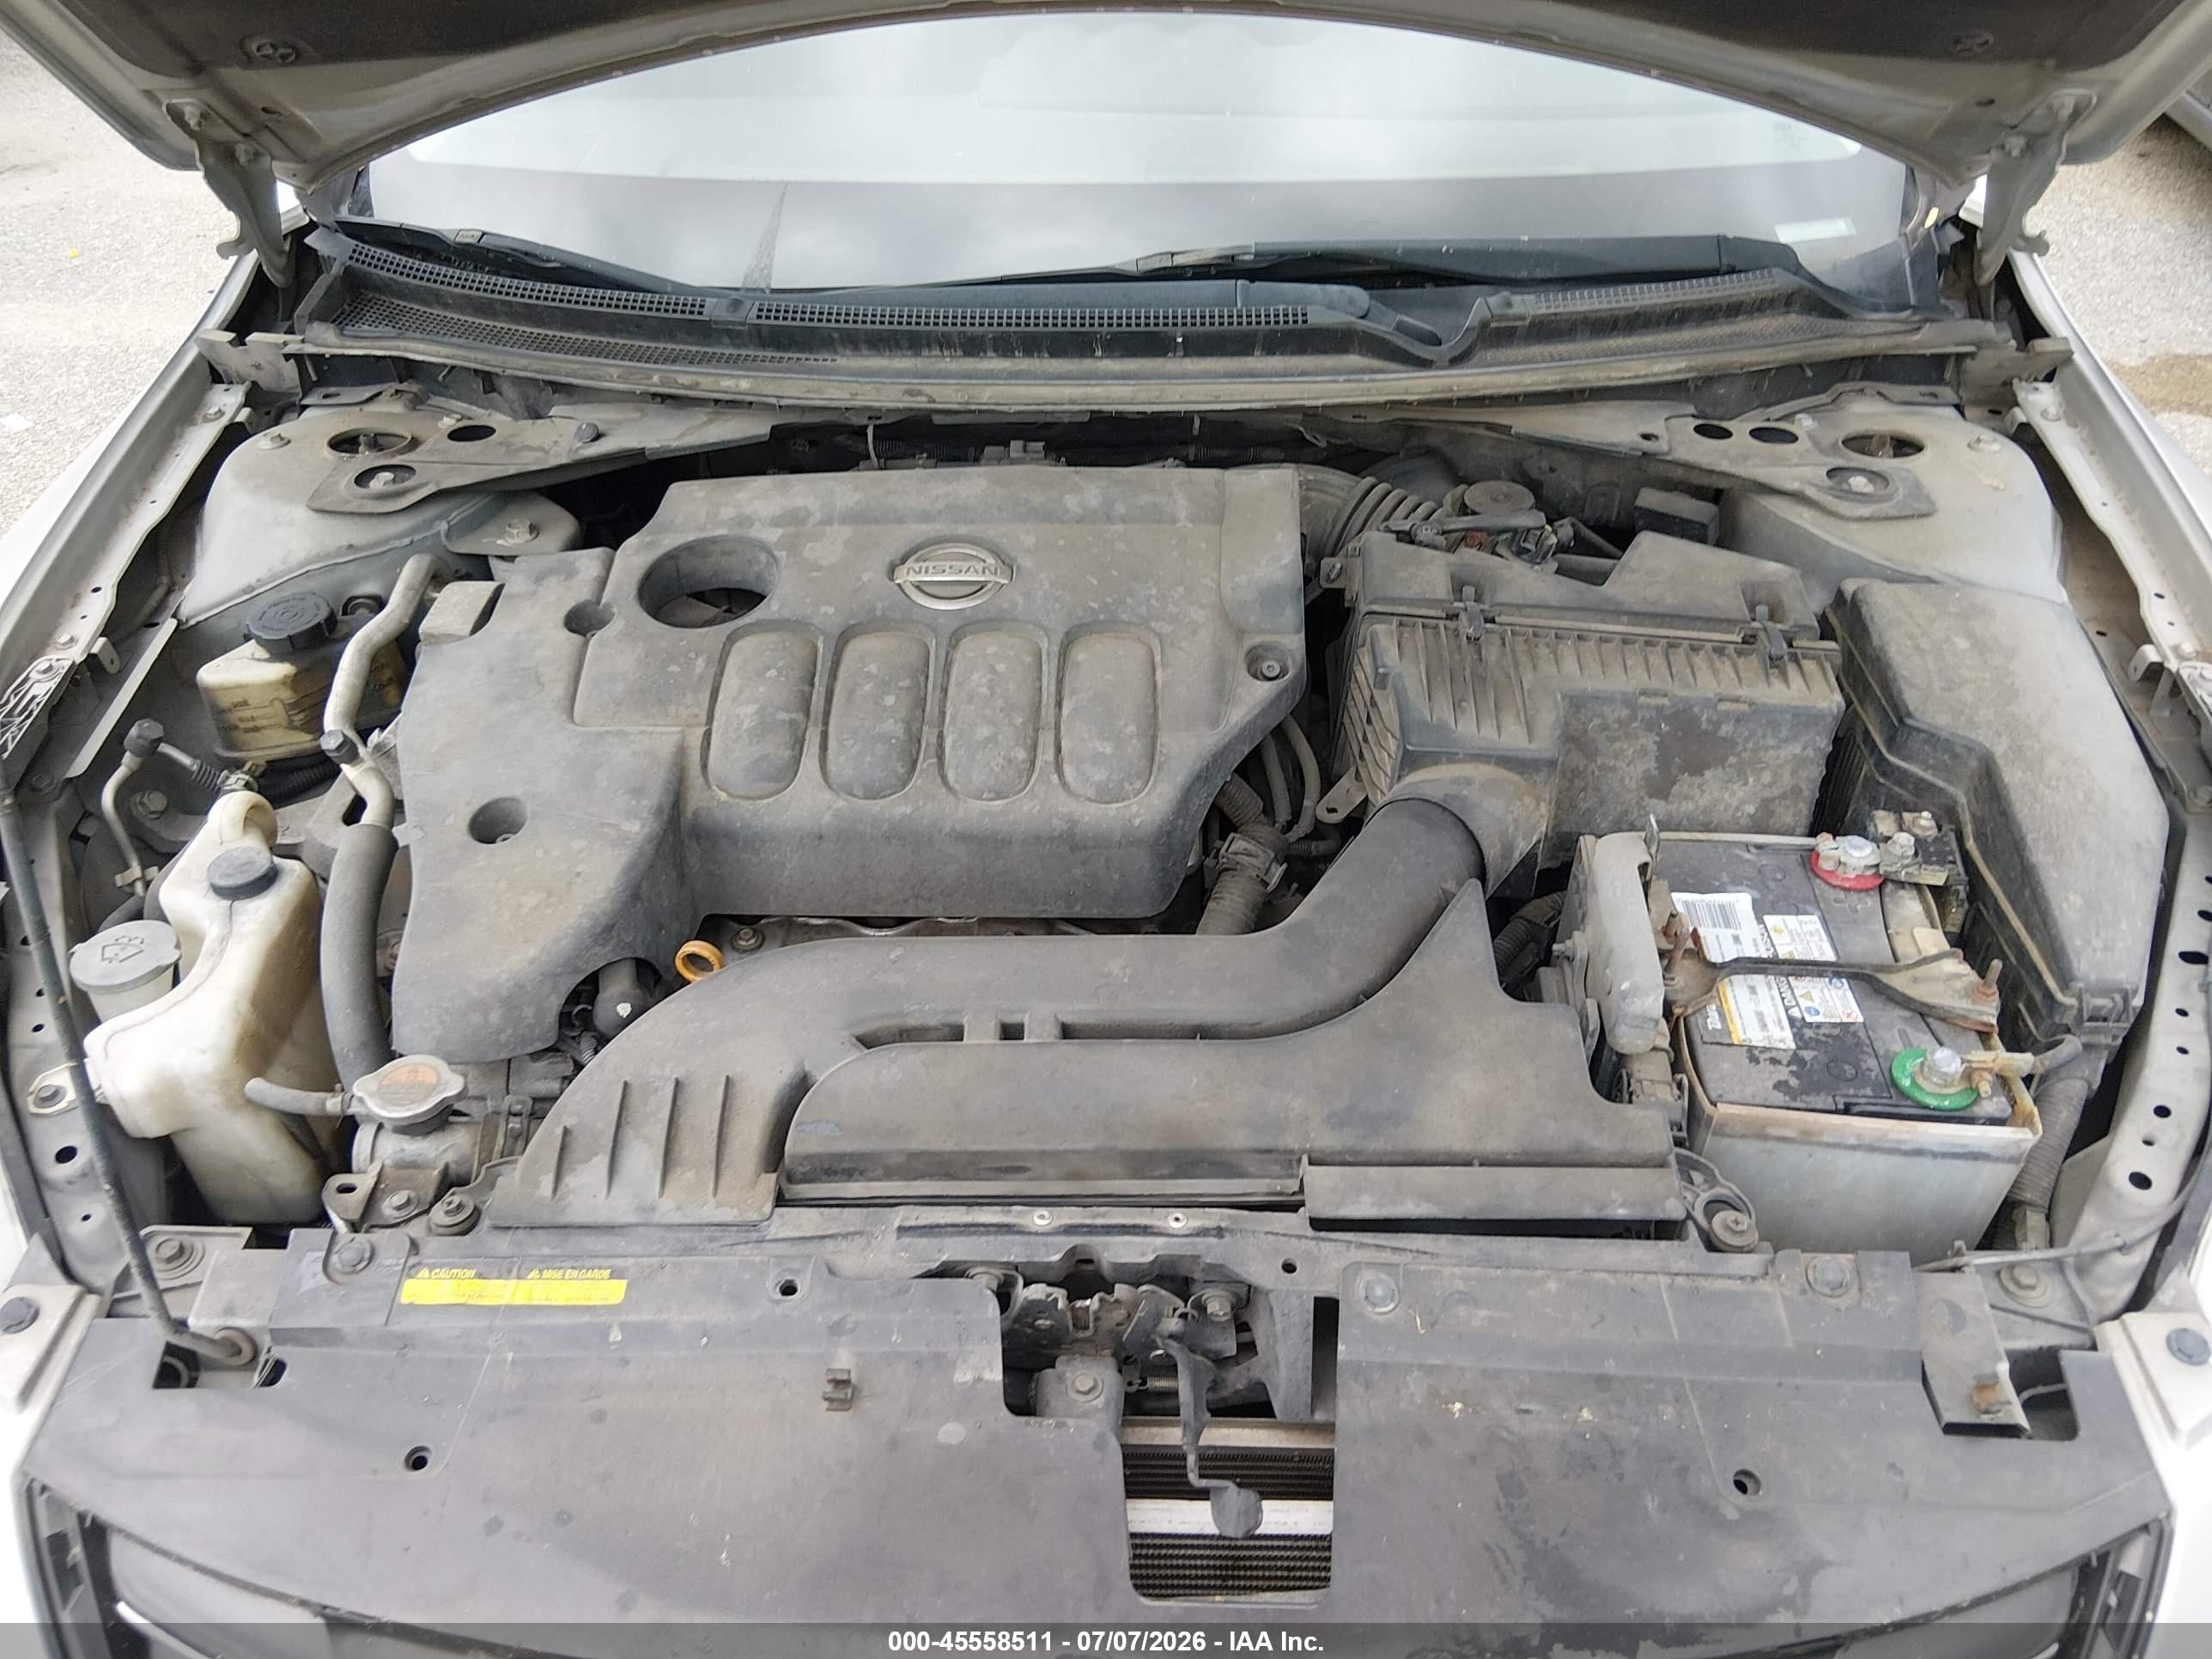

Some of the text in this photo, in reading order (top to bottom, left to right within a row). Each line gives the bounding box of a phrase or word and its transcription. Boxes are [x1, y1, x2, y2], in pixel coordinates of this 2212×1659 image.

[906, 564, 998, 577] NISSAN
[430, 1268, 477, 1279] CAUTION
[541, 1268, 611, 1279] MISE EN GARDE
